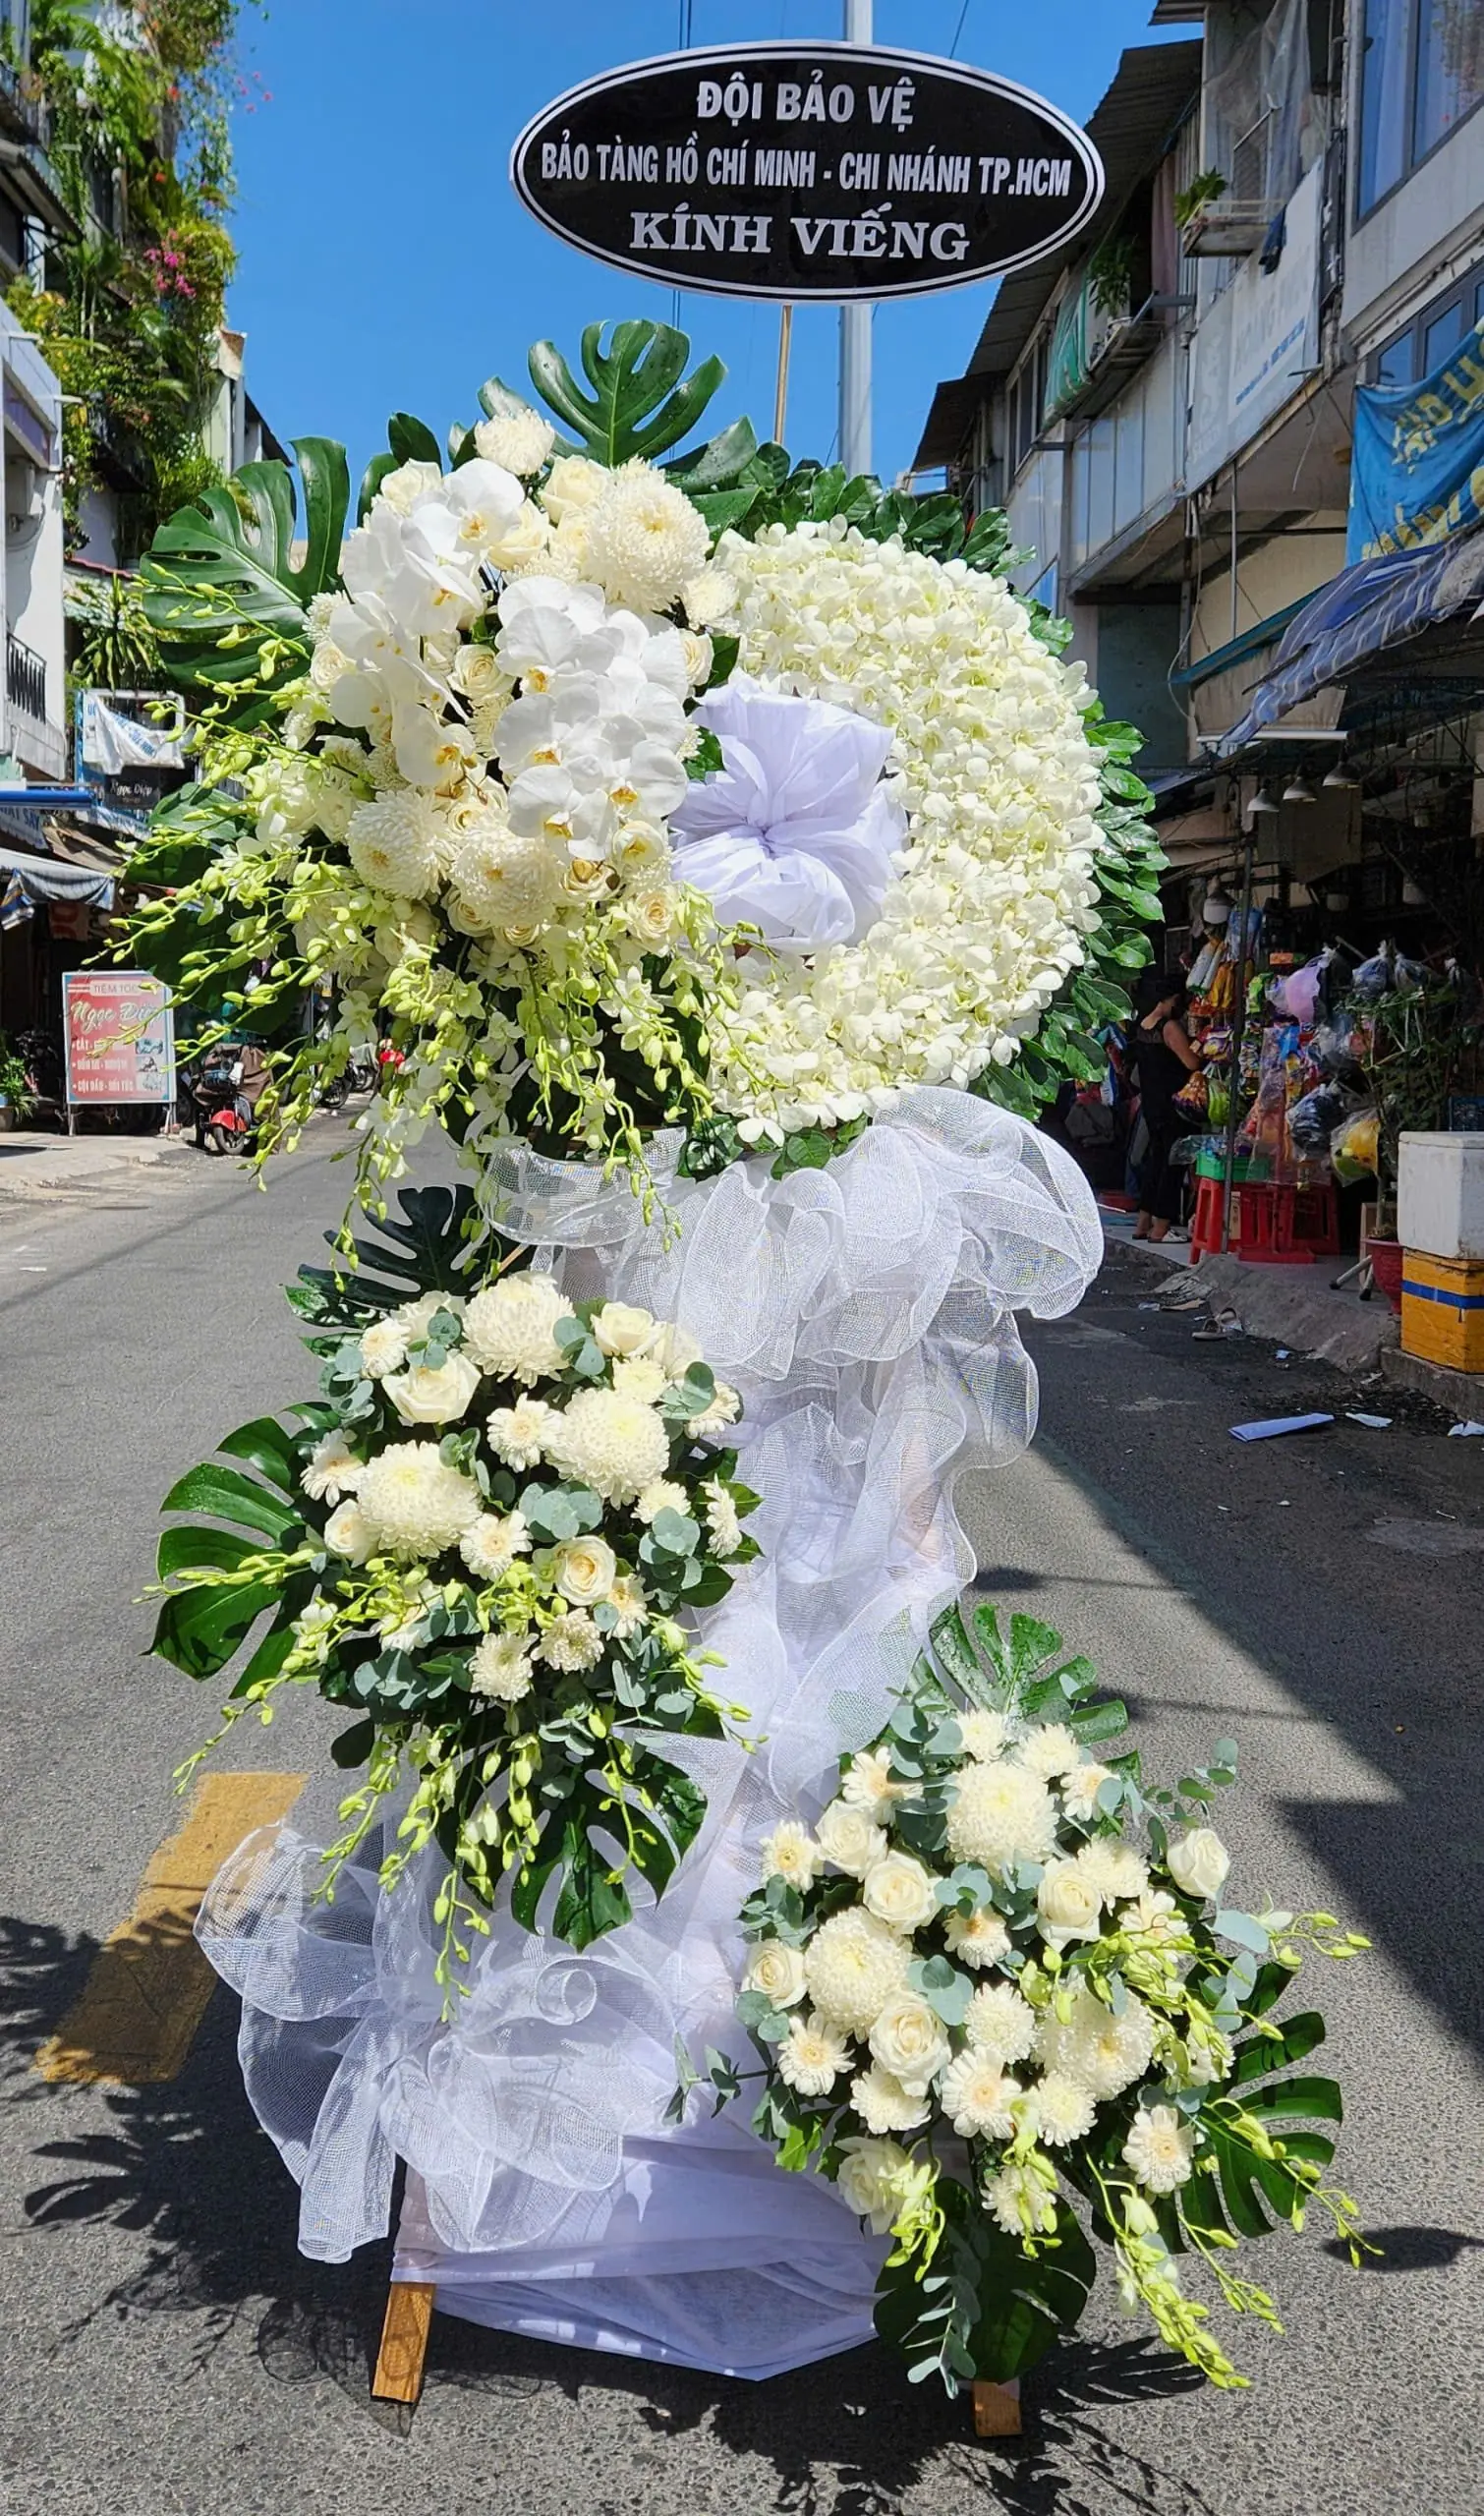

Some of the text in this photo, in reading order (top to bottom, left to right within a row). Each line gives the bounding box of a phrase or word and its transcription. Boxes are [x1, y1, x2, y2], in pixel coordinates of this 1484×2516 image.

[697, 70, 915, 132] ĐỘI BẢO VỆ
[542, 128, 589, 180] BẢO
[597, 136, 657, 182] TÀNG
[666, 132, 698, 184] HỒ
[707, 140, 748, 185] CHÍ
[755, 149, 815, 187] MINH
[840, 152, 880, 190] CHI
[887, 145, 970, 193] NHÁNH
[979, 157, 1071, 196] TP.HCM
[630, 202, 969, 259] KÍNH VIẾNG
